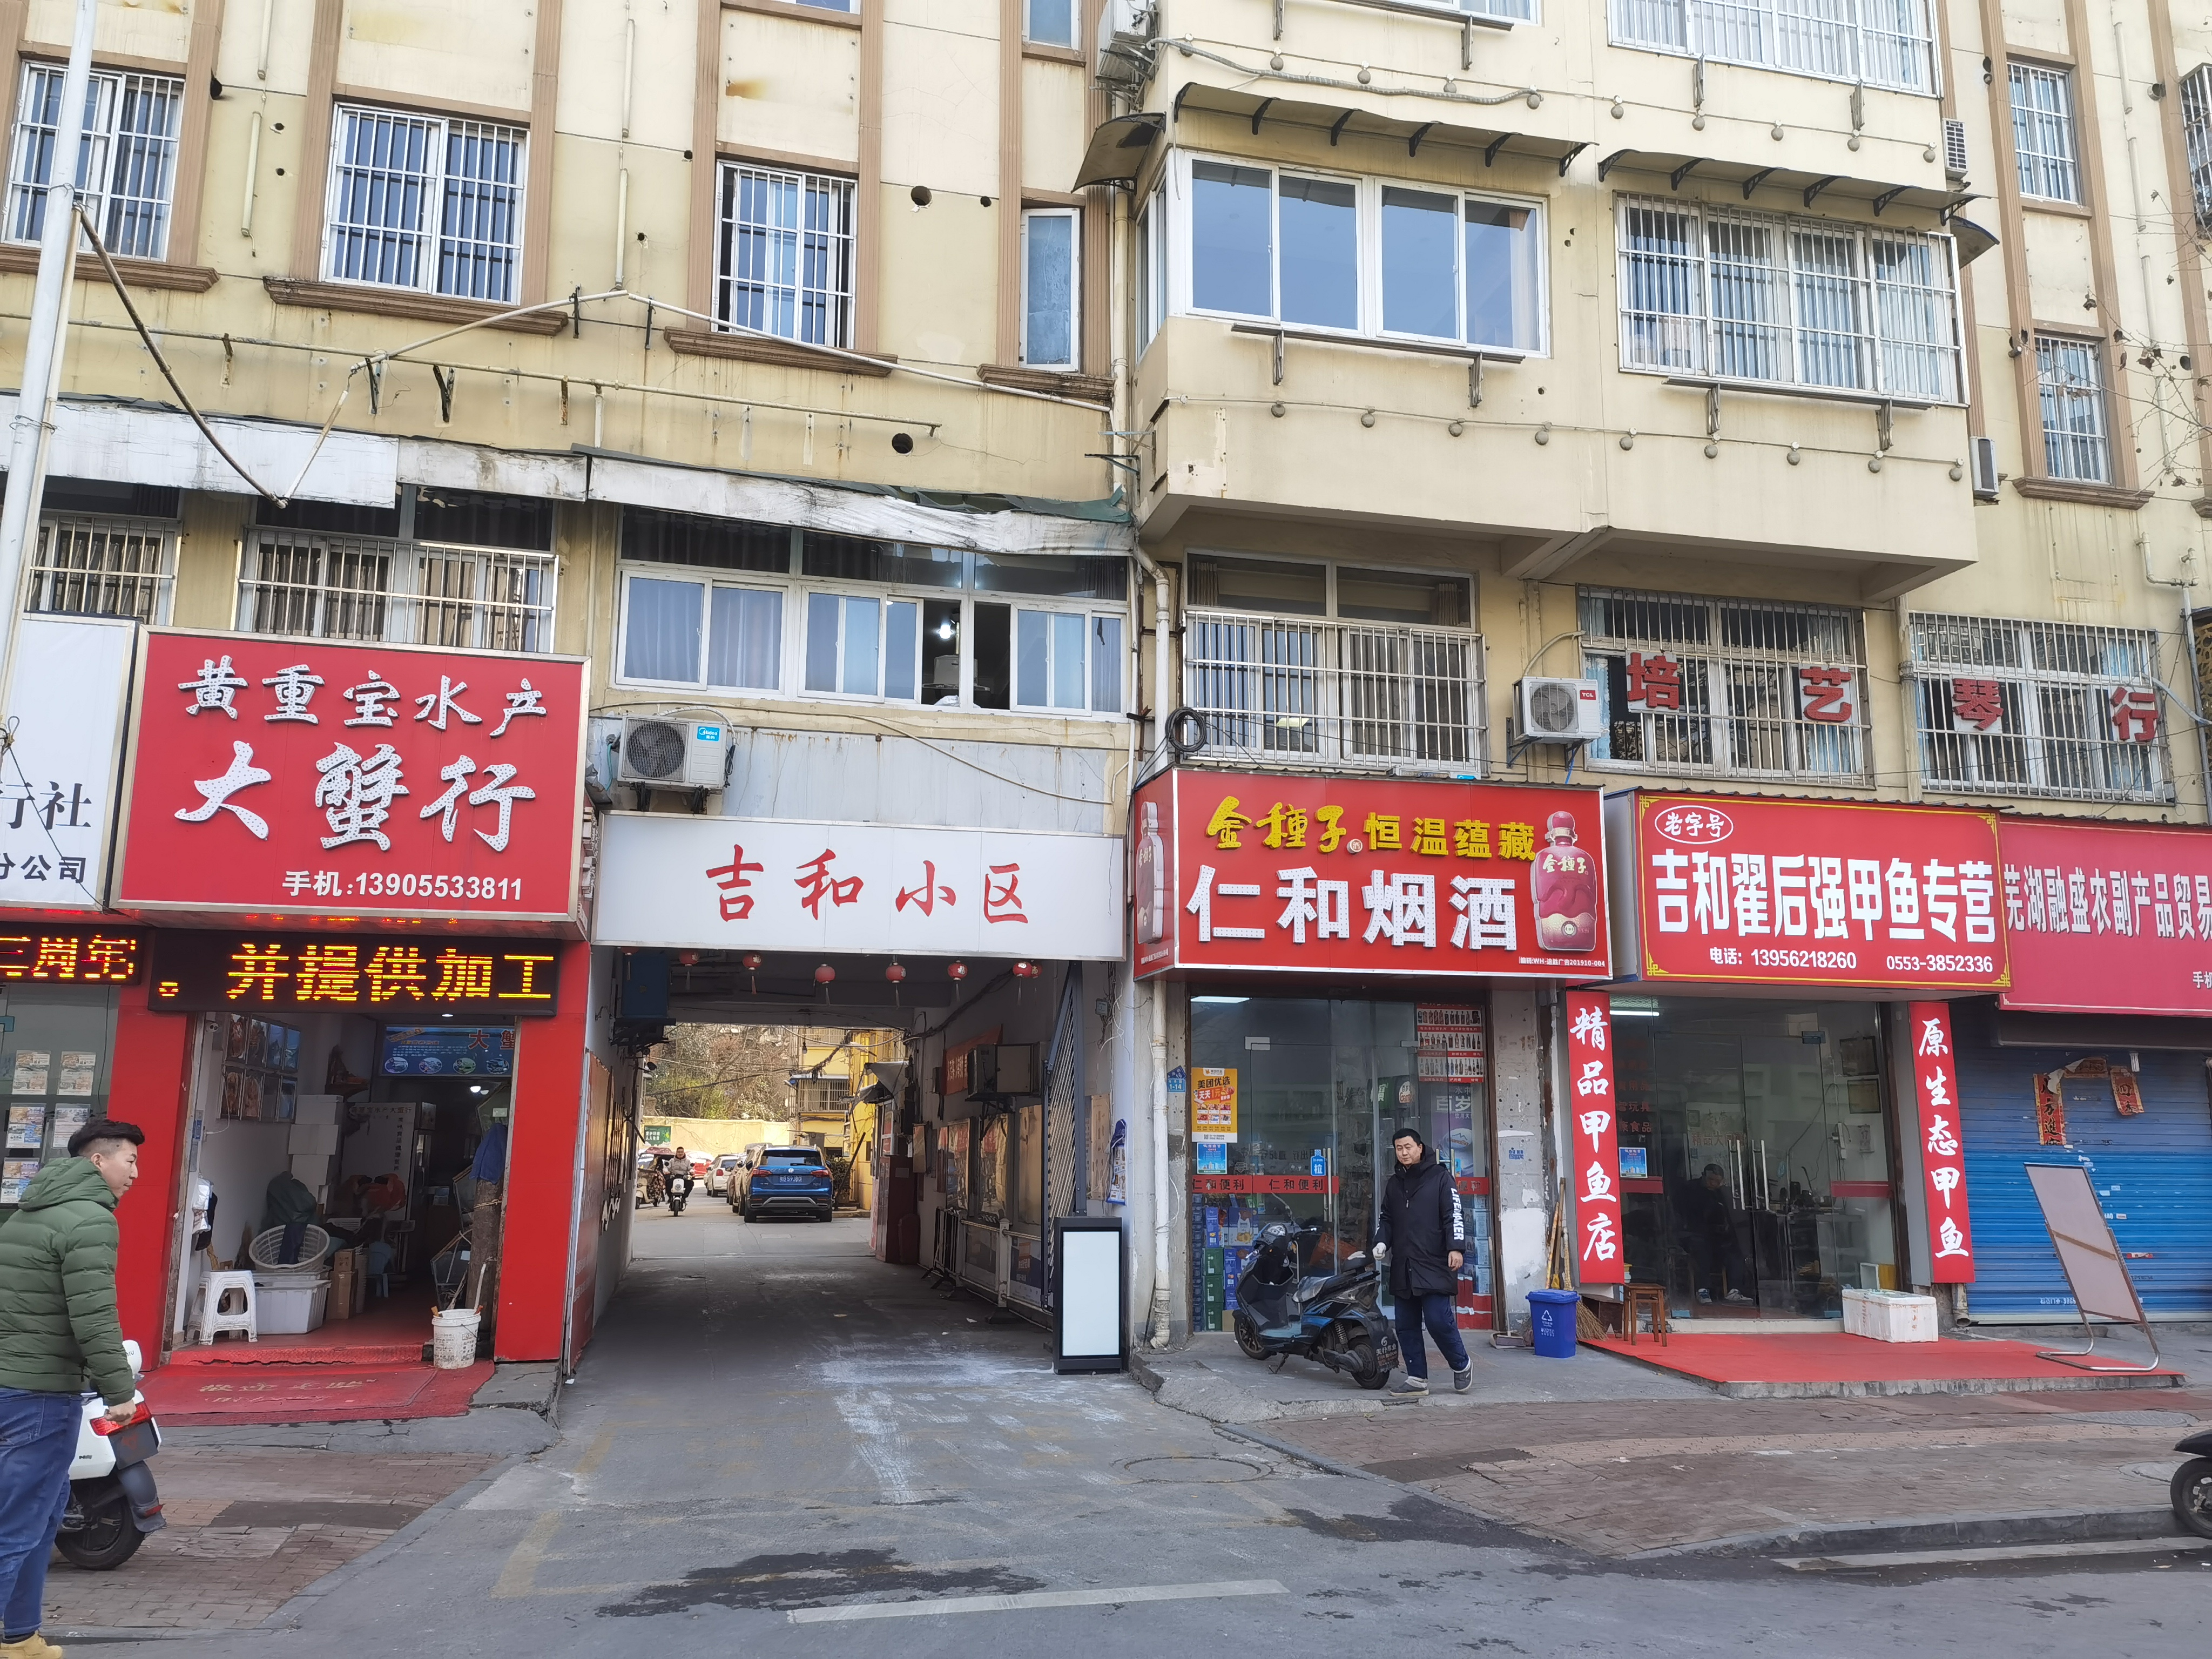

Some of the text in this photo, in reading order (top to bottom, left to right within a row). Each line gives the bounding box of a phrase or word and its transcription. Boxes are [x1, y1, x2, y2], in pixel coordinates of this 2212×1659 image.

[178, 655, 548, 738] 黄重宝水产
[174, 740, 536, 853] 大蟹行
[1664, 811, 1725, 838] 老字号
[1363, 812, 1535, 862] 恒温蕴藏
[705, 844, 1028, 924] 吉和小区
[1185, 864, 1518, 951] 仁和烟酒
[1651, 848, 1995, 943] 吉和翟后强甲鱼专营
[1751, 949, 1857, 969] 13956218260
[1886, 954, 1993, 973] 0553-3852336
[1197, 1076, 1230, 1089] 美团优选
[1570, 1006, 1617, 1262] 精品甲鱼店
[1918, 1017, 1969, 1260] 原生态甲鱼
[1192, 1179, 1244, 1190] 仁和便利
[1269, 1179, 1323, 1190] 仁和便利
